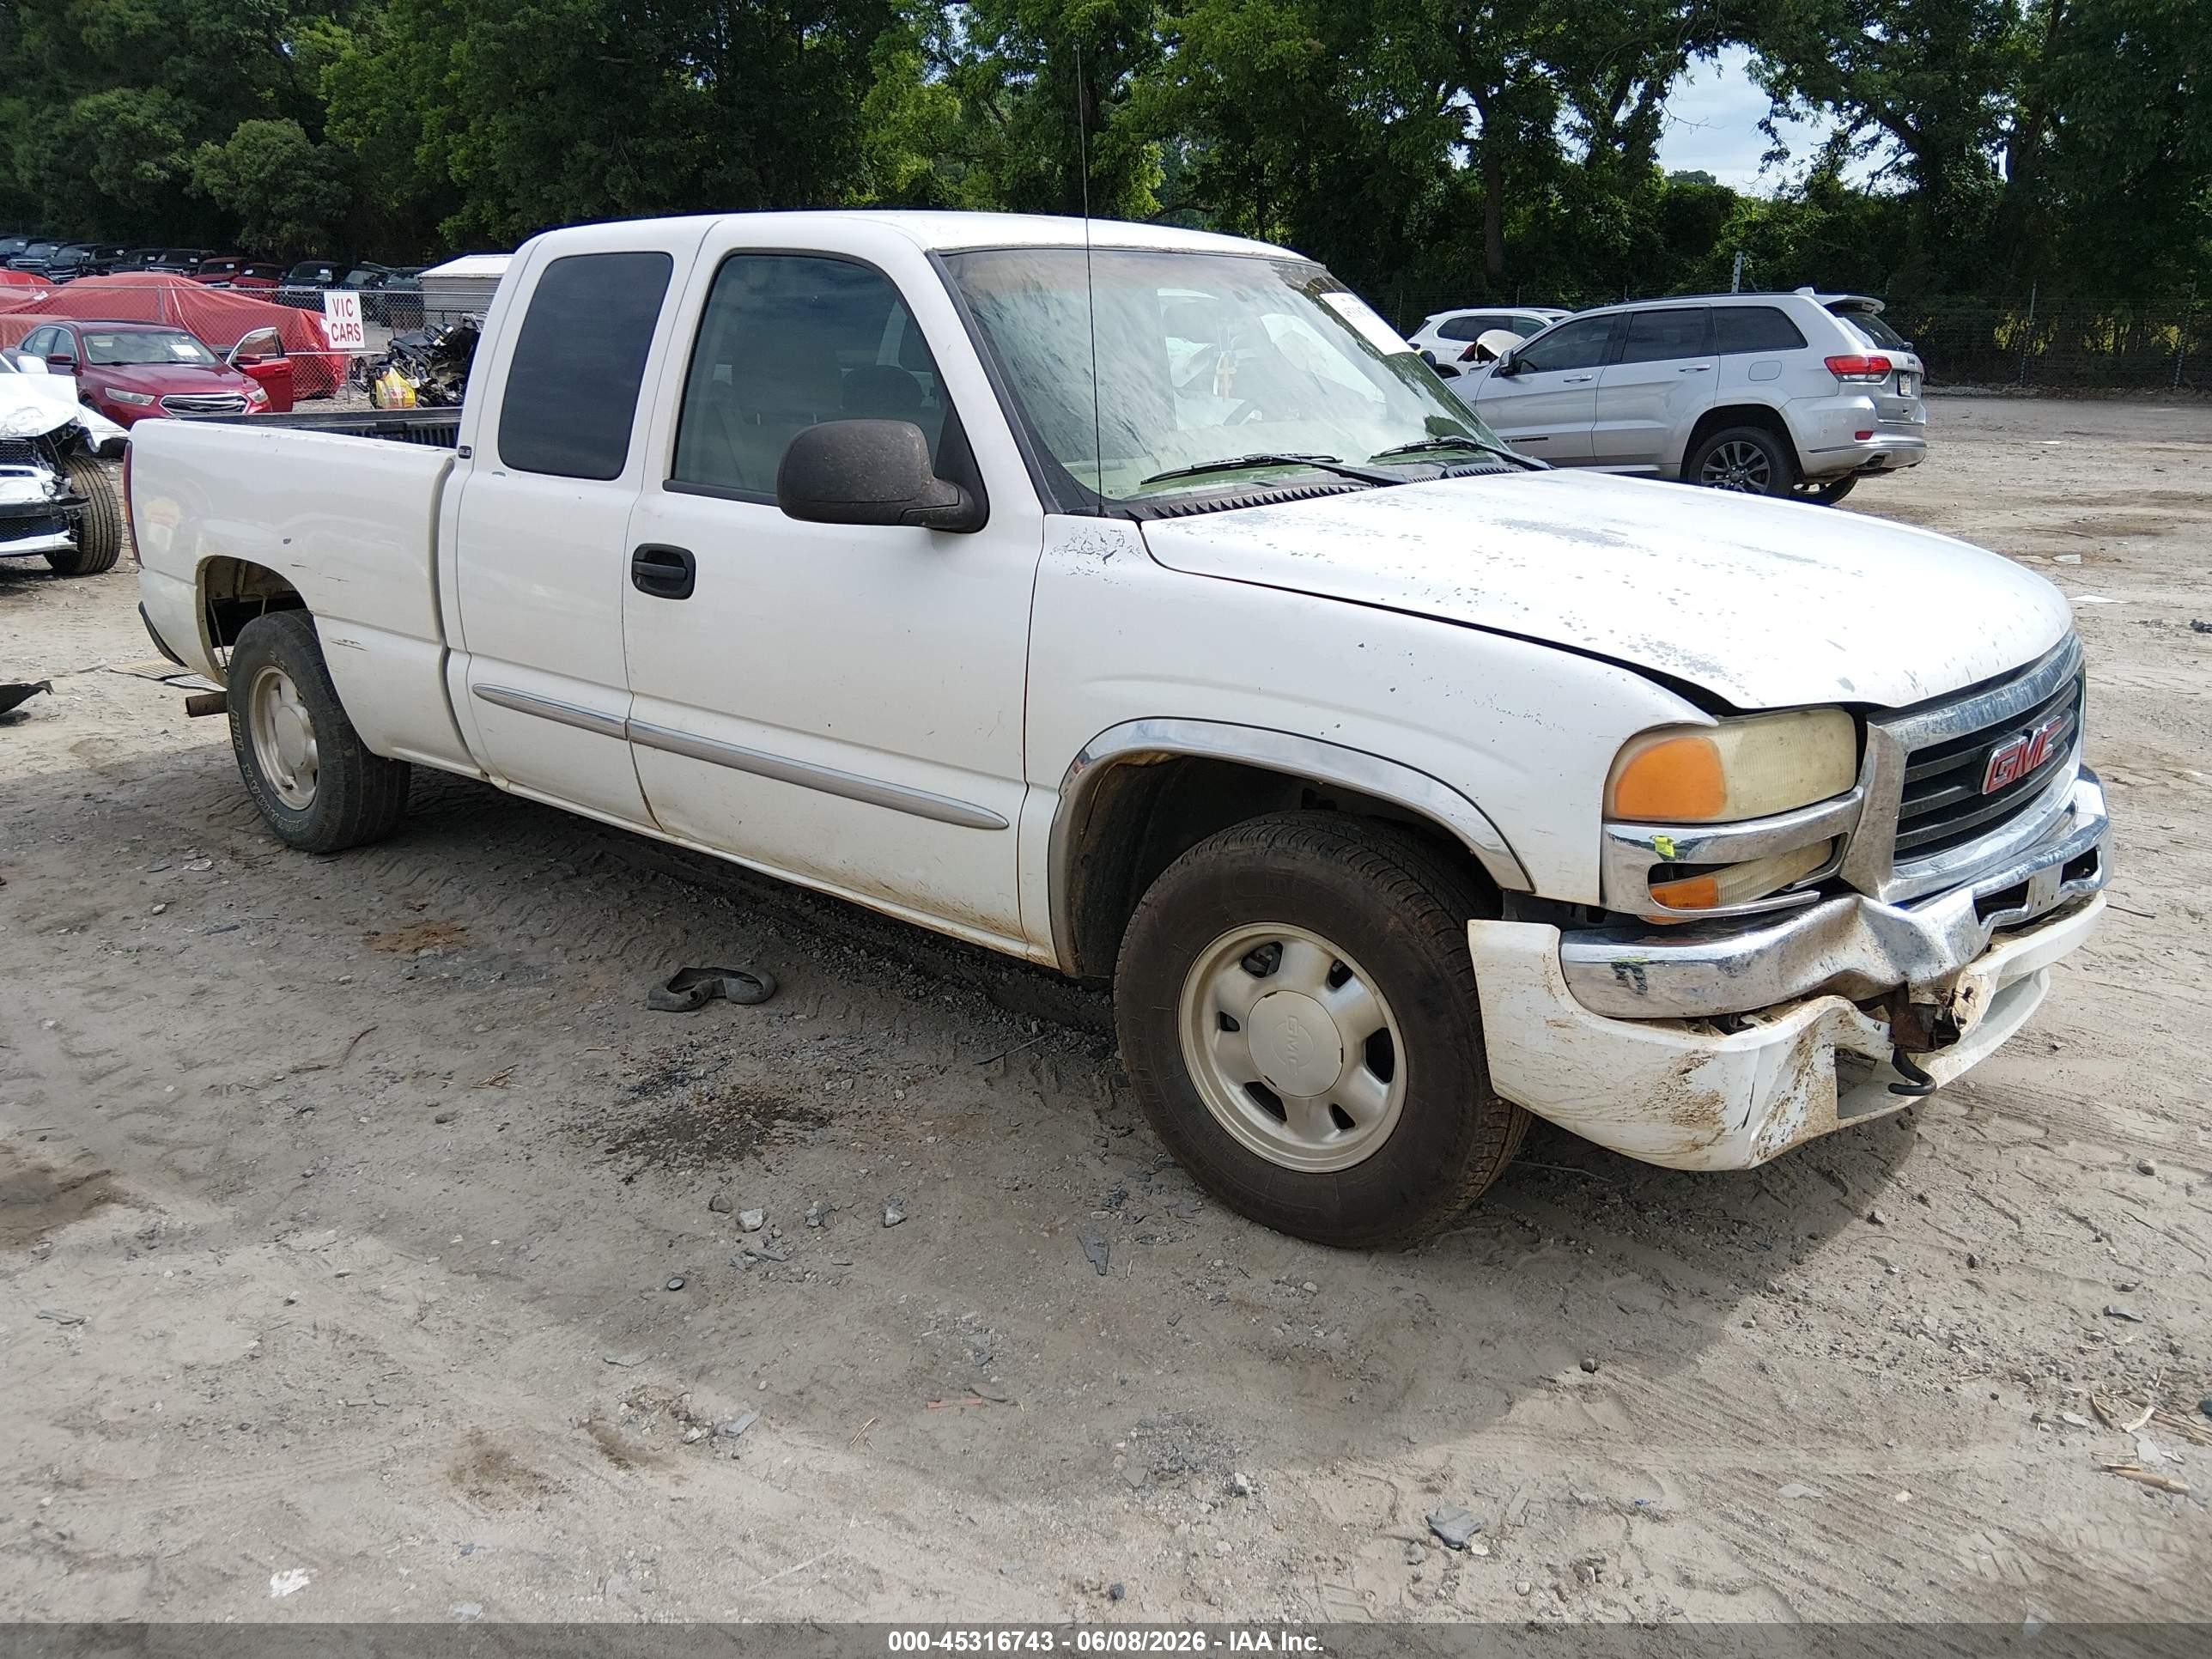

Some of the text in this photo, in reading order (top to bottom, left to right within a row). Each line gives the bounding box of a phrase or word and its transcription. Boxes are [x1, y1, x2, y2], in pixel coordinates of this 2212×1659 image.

[332, 298, 353, 317] VIC
[331, 323, 361, 342] CARS
[1982, 716, 2062, 795] GMC
